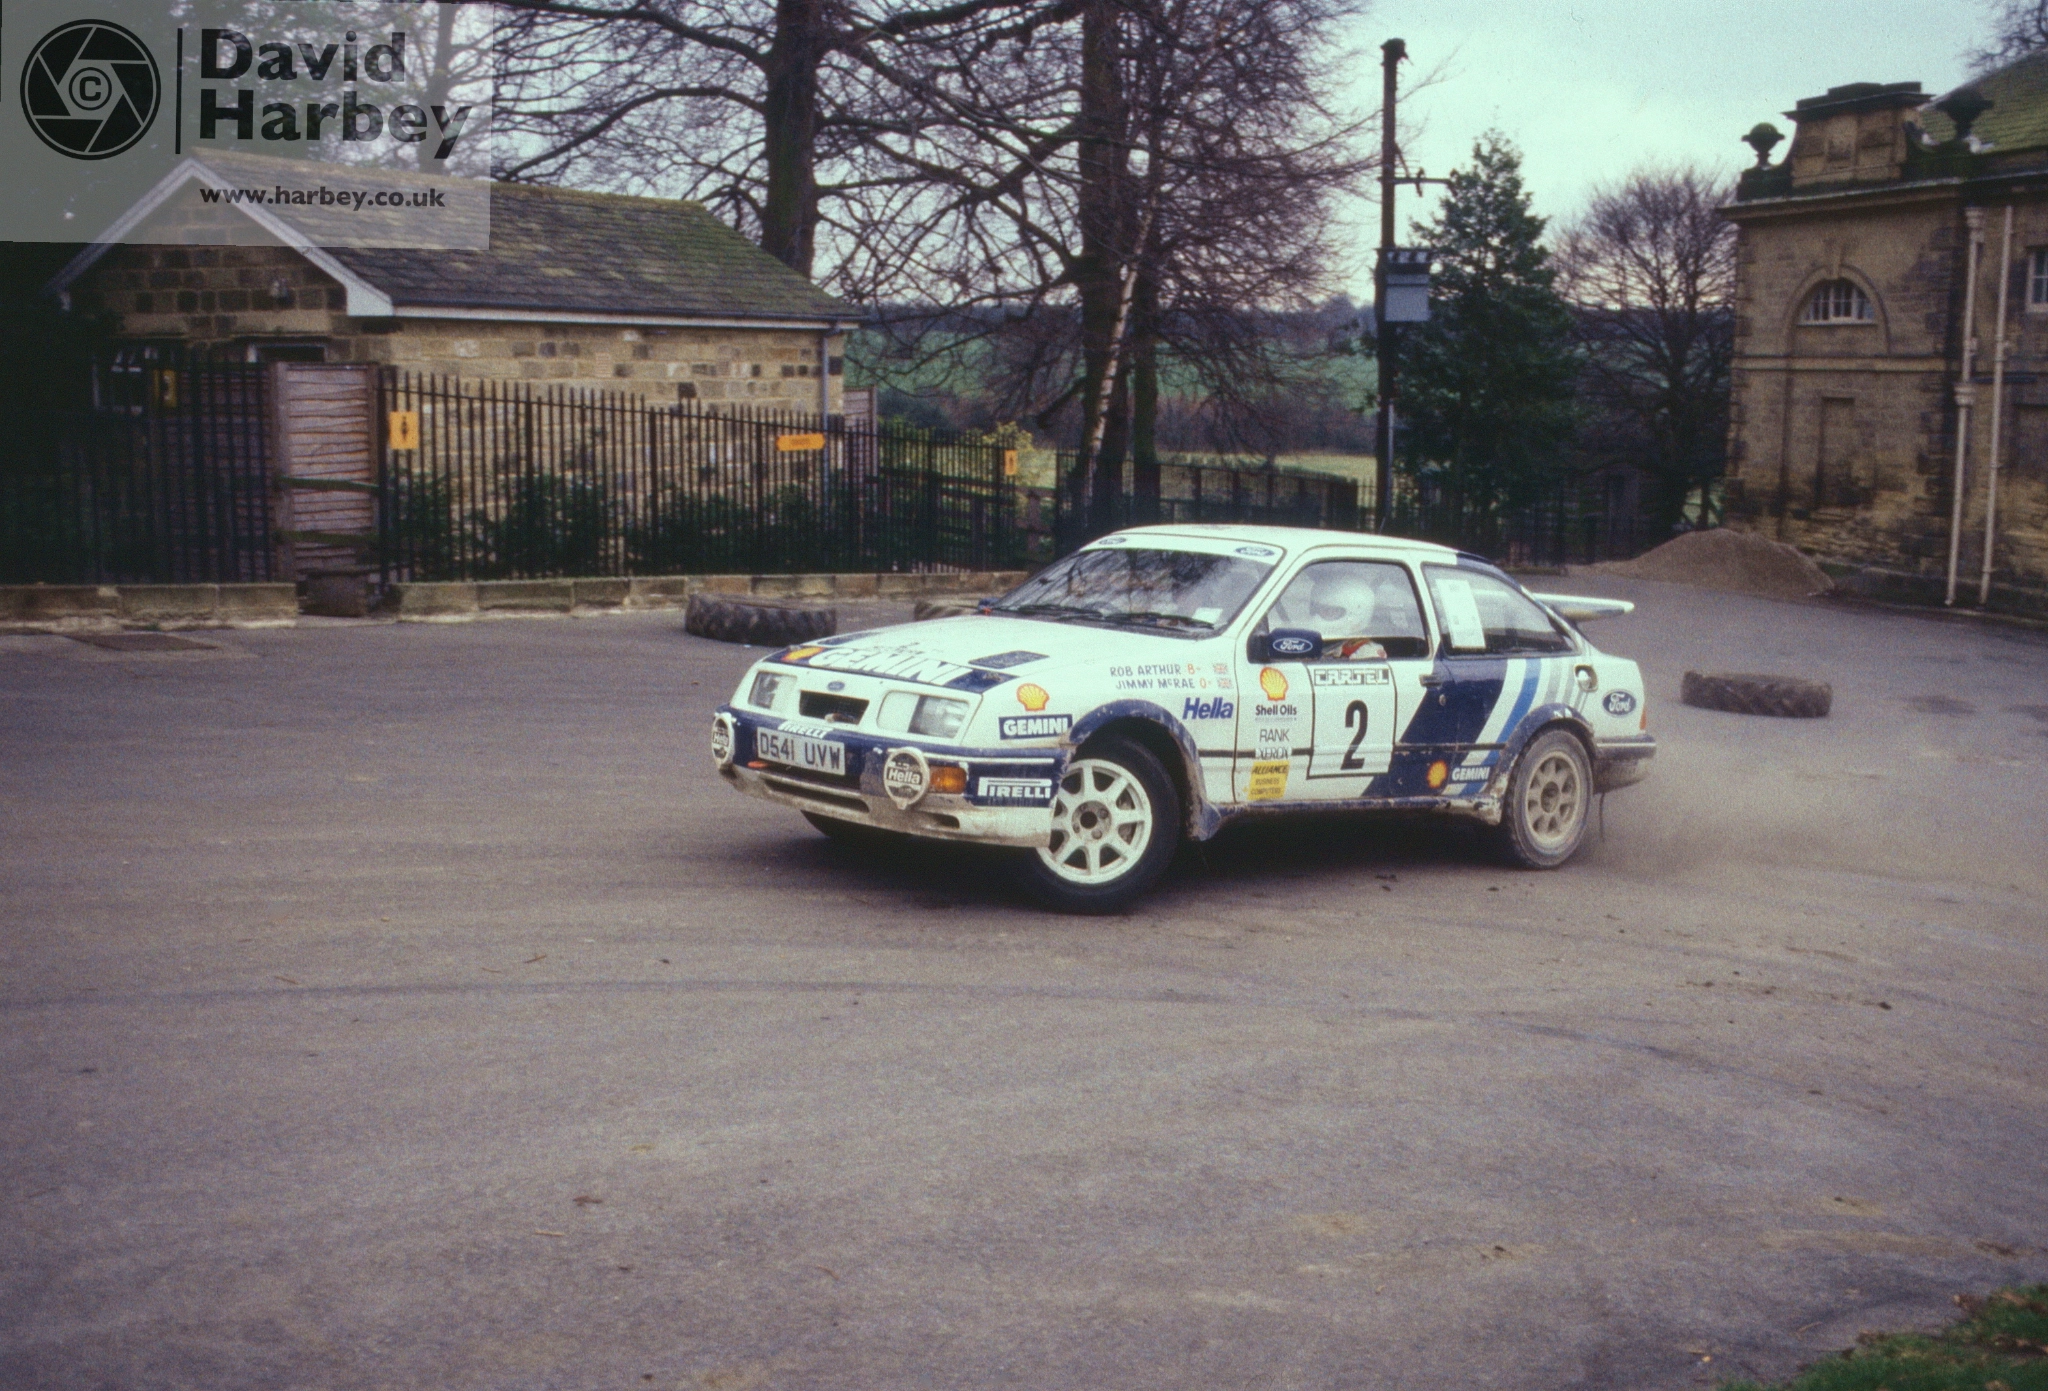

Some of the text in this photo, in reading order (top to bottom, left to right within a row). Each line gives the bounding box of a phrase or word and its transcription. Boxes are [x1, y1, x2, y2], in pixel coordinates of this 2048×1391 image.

[1279, 641, 1305, 651] Ford
[1110, 667, 1133, 677] ROB
[1137, 664, 1181, 675] ARTHUR
[1314, 669, 1389, 686] CARTEL
[1116, 679, 1153, 690] JIMMY
[1182, 697, 1234, 719] Hella
[1255, 704, 1297, 716] Shell Oils
[1608, 694, 1631, 712] Ford
[1003, 718, 1068, 737] GEMINI
[1259, 728, 1290, 742] RANK
[1340, 700, 1368, 770] 2
[760, 732, 840, 770] D541 UVW
[889, 768, 920, 784] Hella
[1452, 766, 1490, 781] GEMINI
[978, 777, 1051, 799] PIRELLI
